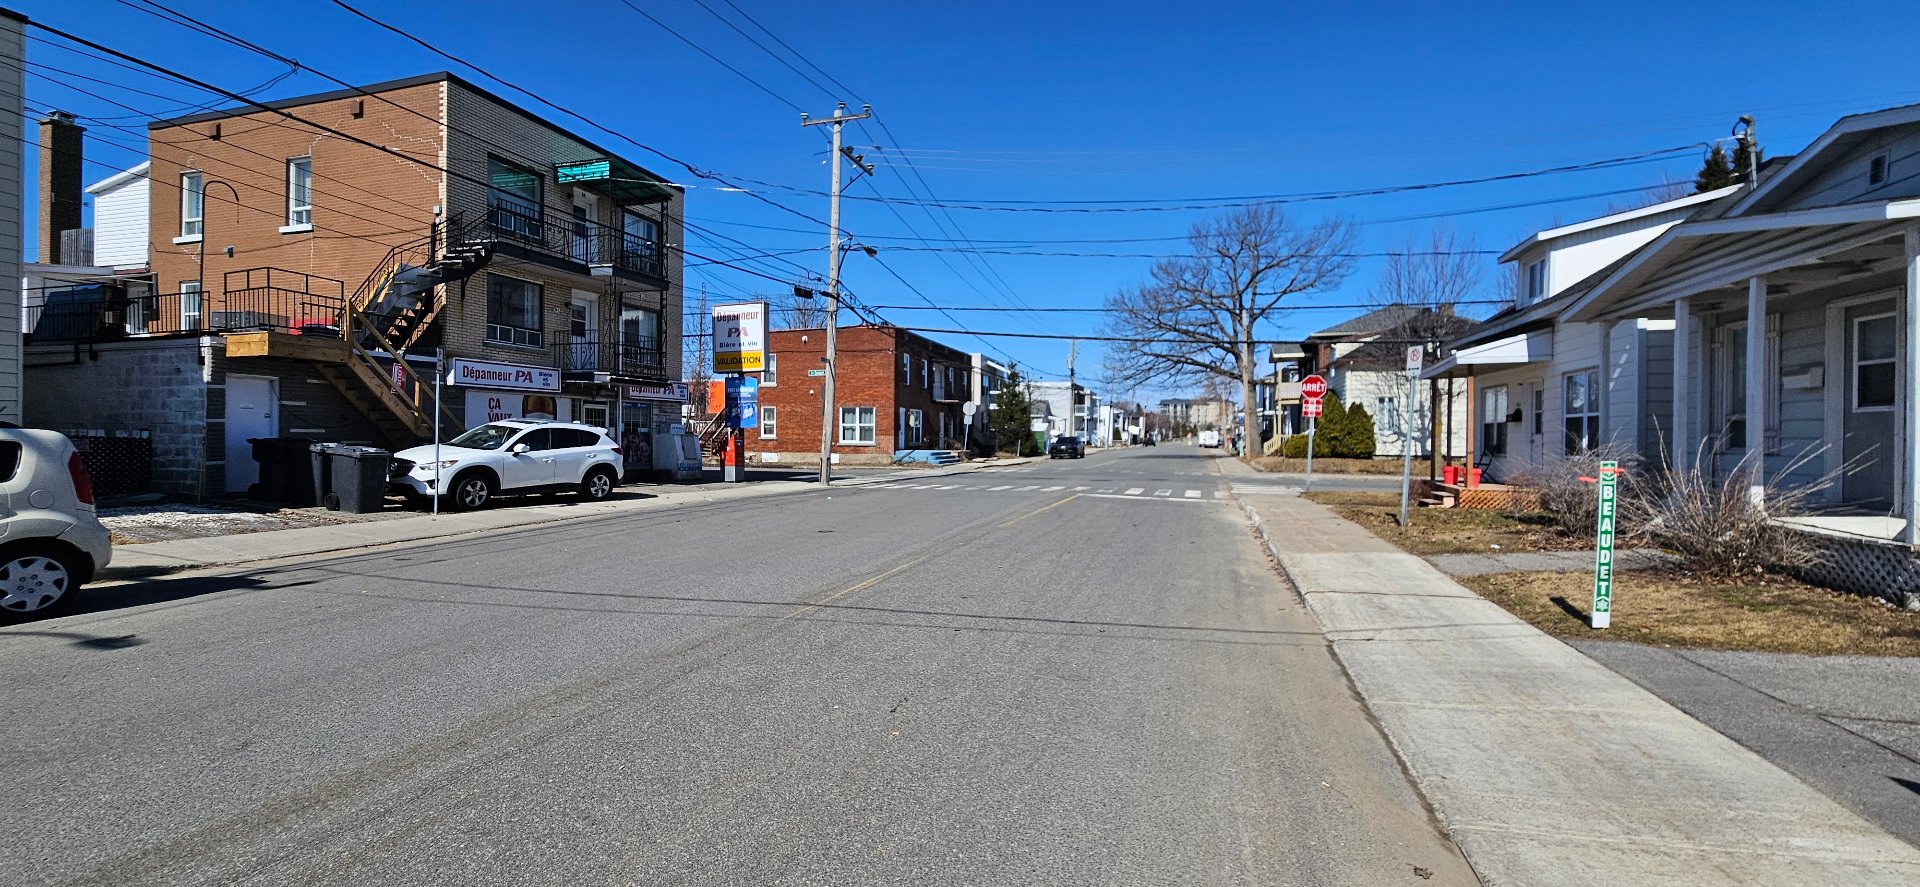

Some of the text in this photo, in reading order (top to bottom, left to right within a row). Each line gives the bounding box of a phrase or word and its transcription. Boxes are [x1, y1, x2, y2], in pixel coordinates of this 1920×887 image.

[717, 312, 759, 324] Dépanneur
[728, 327, 748, 338] PA
[717, 356, 761, 366] VALIDATION
[462, 365, 534, 384] Dépanneur PA
[1302, 380, 1326, 393] ARRÊT
[488, 397, 502, 412] ÇA
[1599, 485, 1614, 595] BEAUDET
